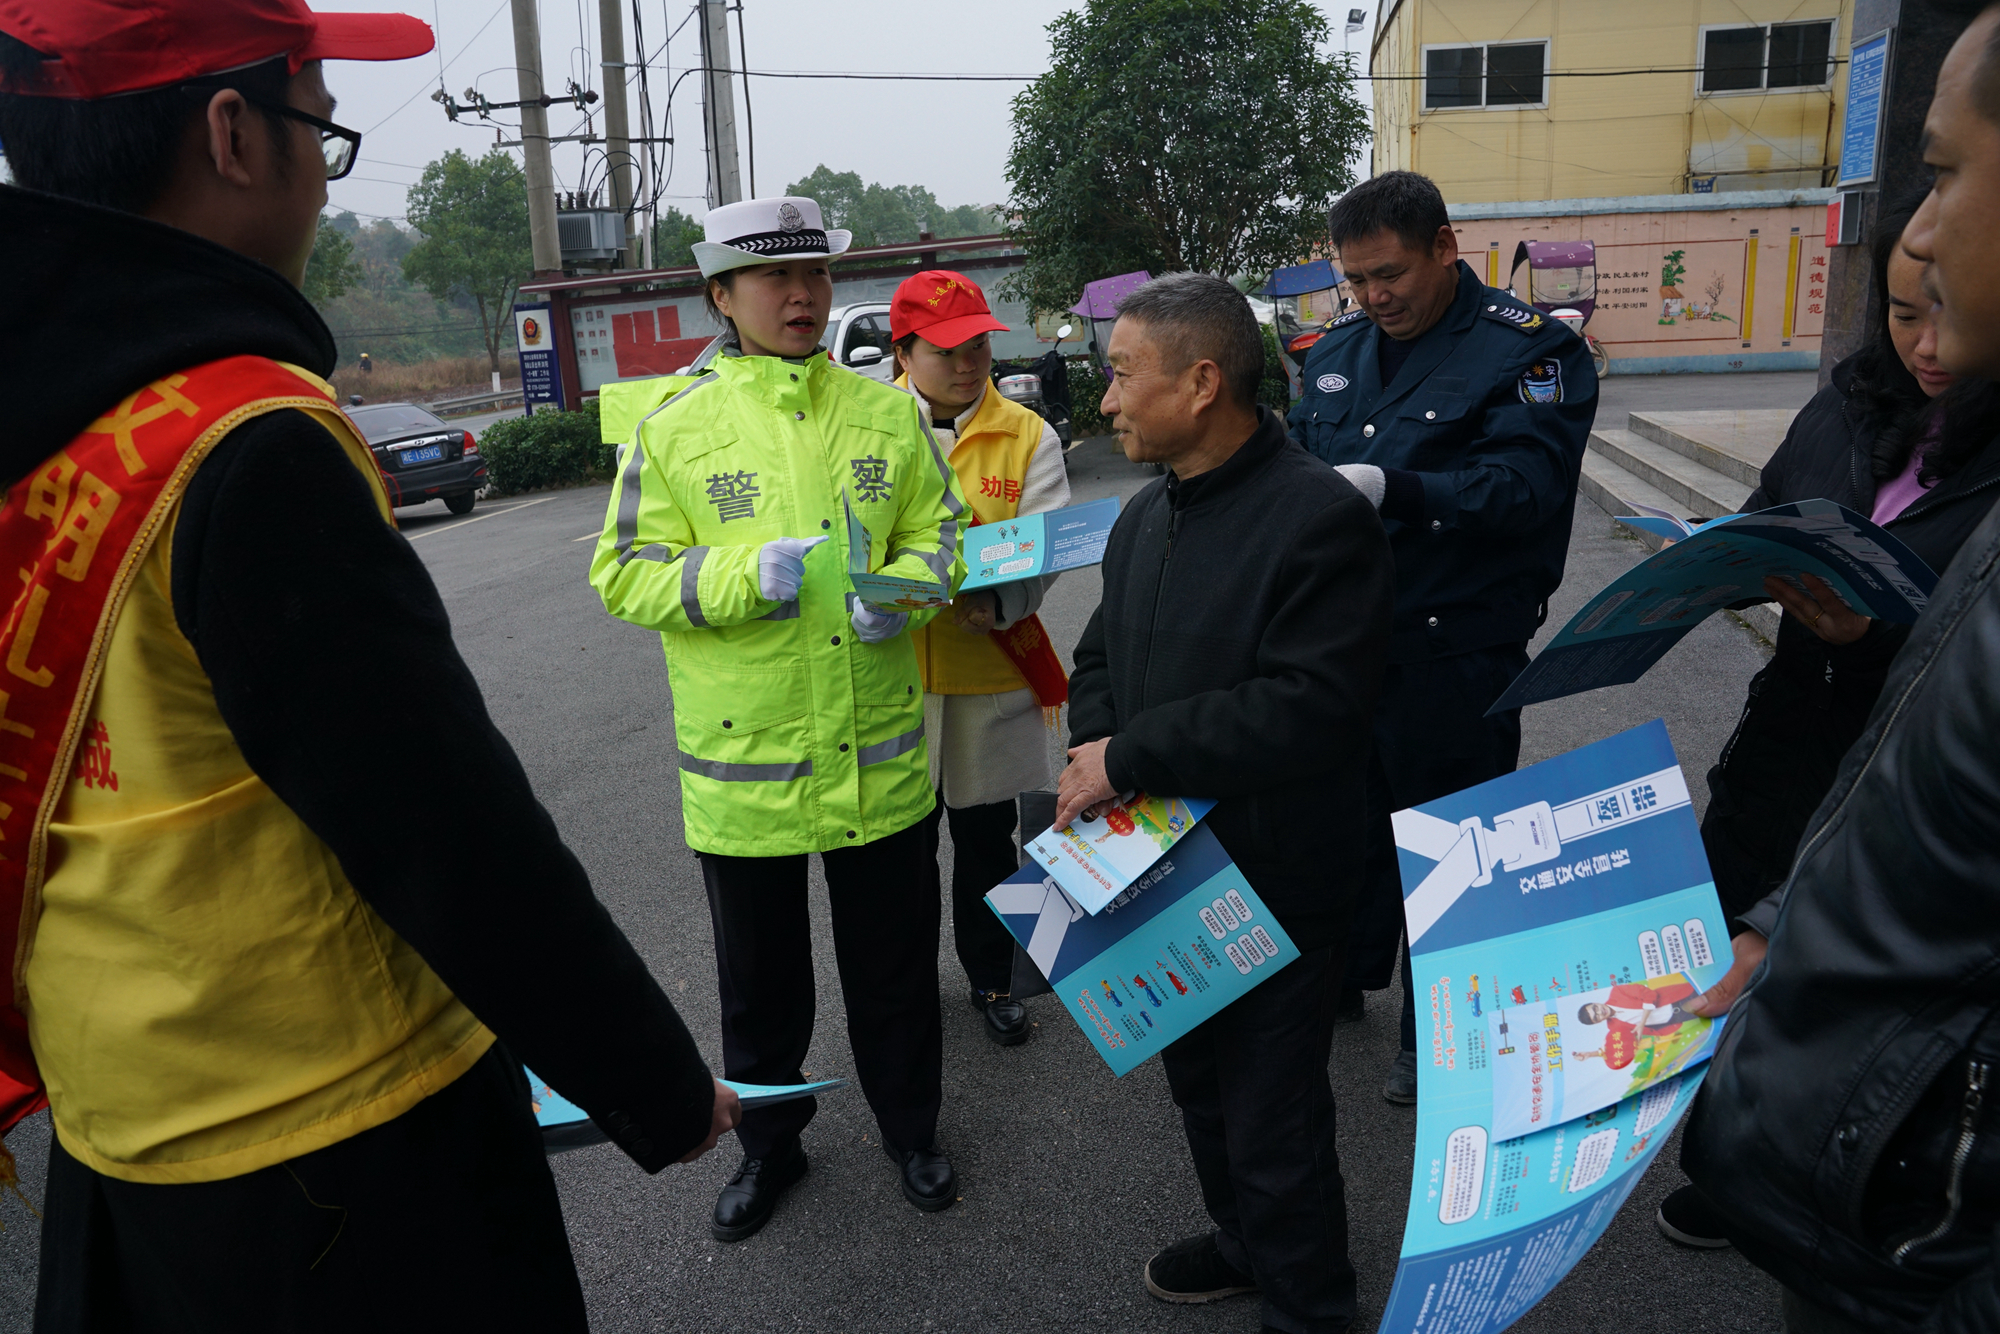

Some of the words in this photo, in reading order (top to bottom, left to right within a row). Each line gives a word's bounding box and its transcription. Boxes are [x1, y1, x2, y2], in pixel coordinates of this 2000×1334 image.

[1808, 255, 1827, 314] 道德规范
[705, 469, 762, 524] 警
[850, 454, 894, 503] 察
[979, 475, 1021, 503] 劝导
[1109, 814, 1130, 833] 平安是福
[1585, 783, 1658, 826] 一盔一带
[1103, 858, 1176, 915] 交通安全宣传
[1517, 847, 1632, 895] 交通安全宣传
[1543, 1012, 1563, 1073] 工作手册
[1611, 1031, 1624, 1067] 平安是福
[1528, 1032, 1543, 1123] 农村交通安全协管员
